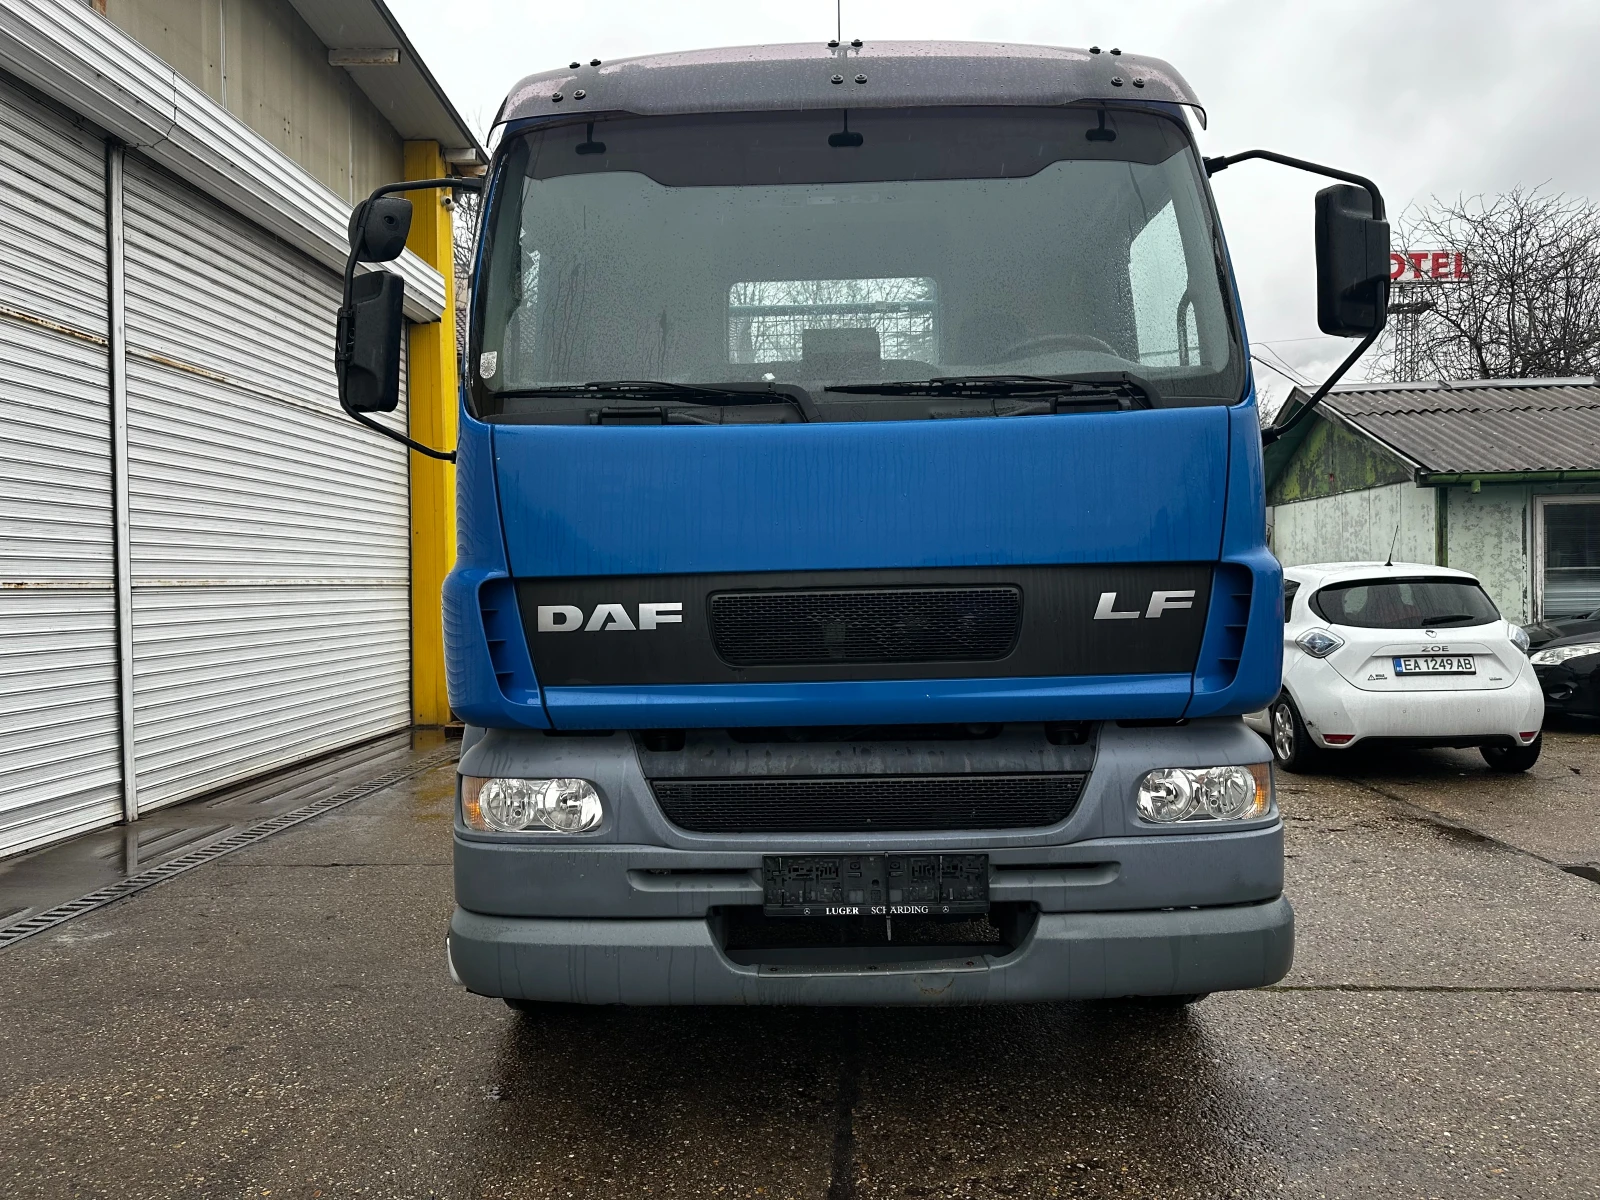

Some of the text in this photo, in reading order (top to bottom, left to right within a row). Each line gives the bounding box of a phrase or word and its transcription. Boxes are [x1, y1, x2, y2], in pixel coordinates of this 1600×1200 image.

[1093, 590, 1196, 620] LF
[537, 602, 683, 632] DAF
[1421, 645, 1450, 653] ZOE
[1403, 659, 1421, 671] EA
[1424, 658, 1453, 670] 1249
[1457, 658, 1473, 670] AB
[825, 906, 859, 915] LUGER
